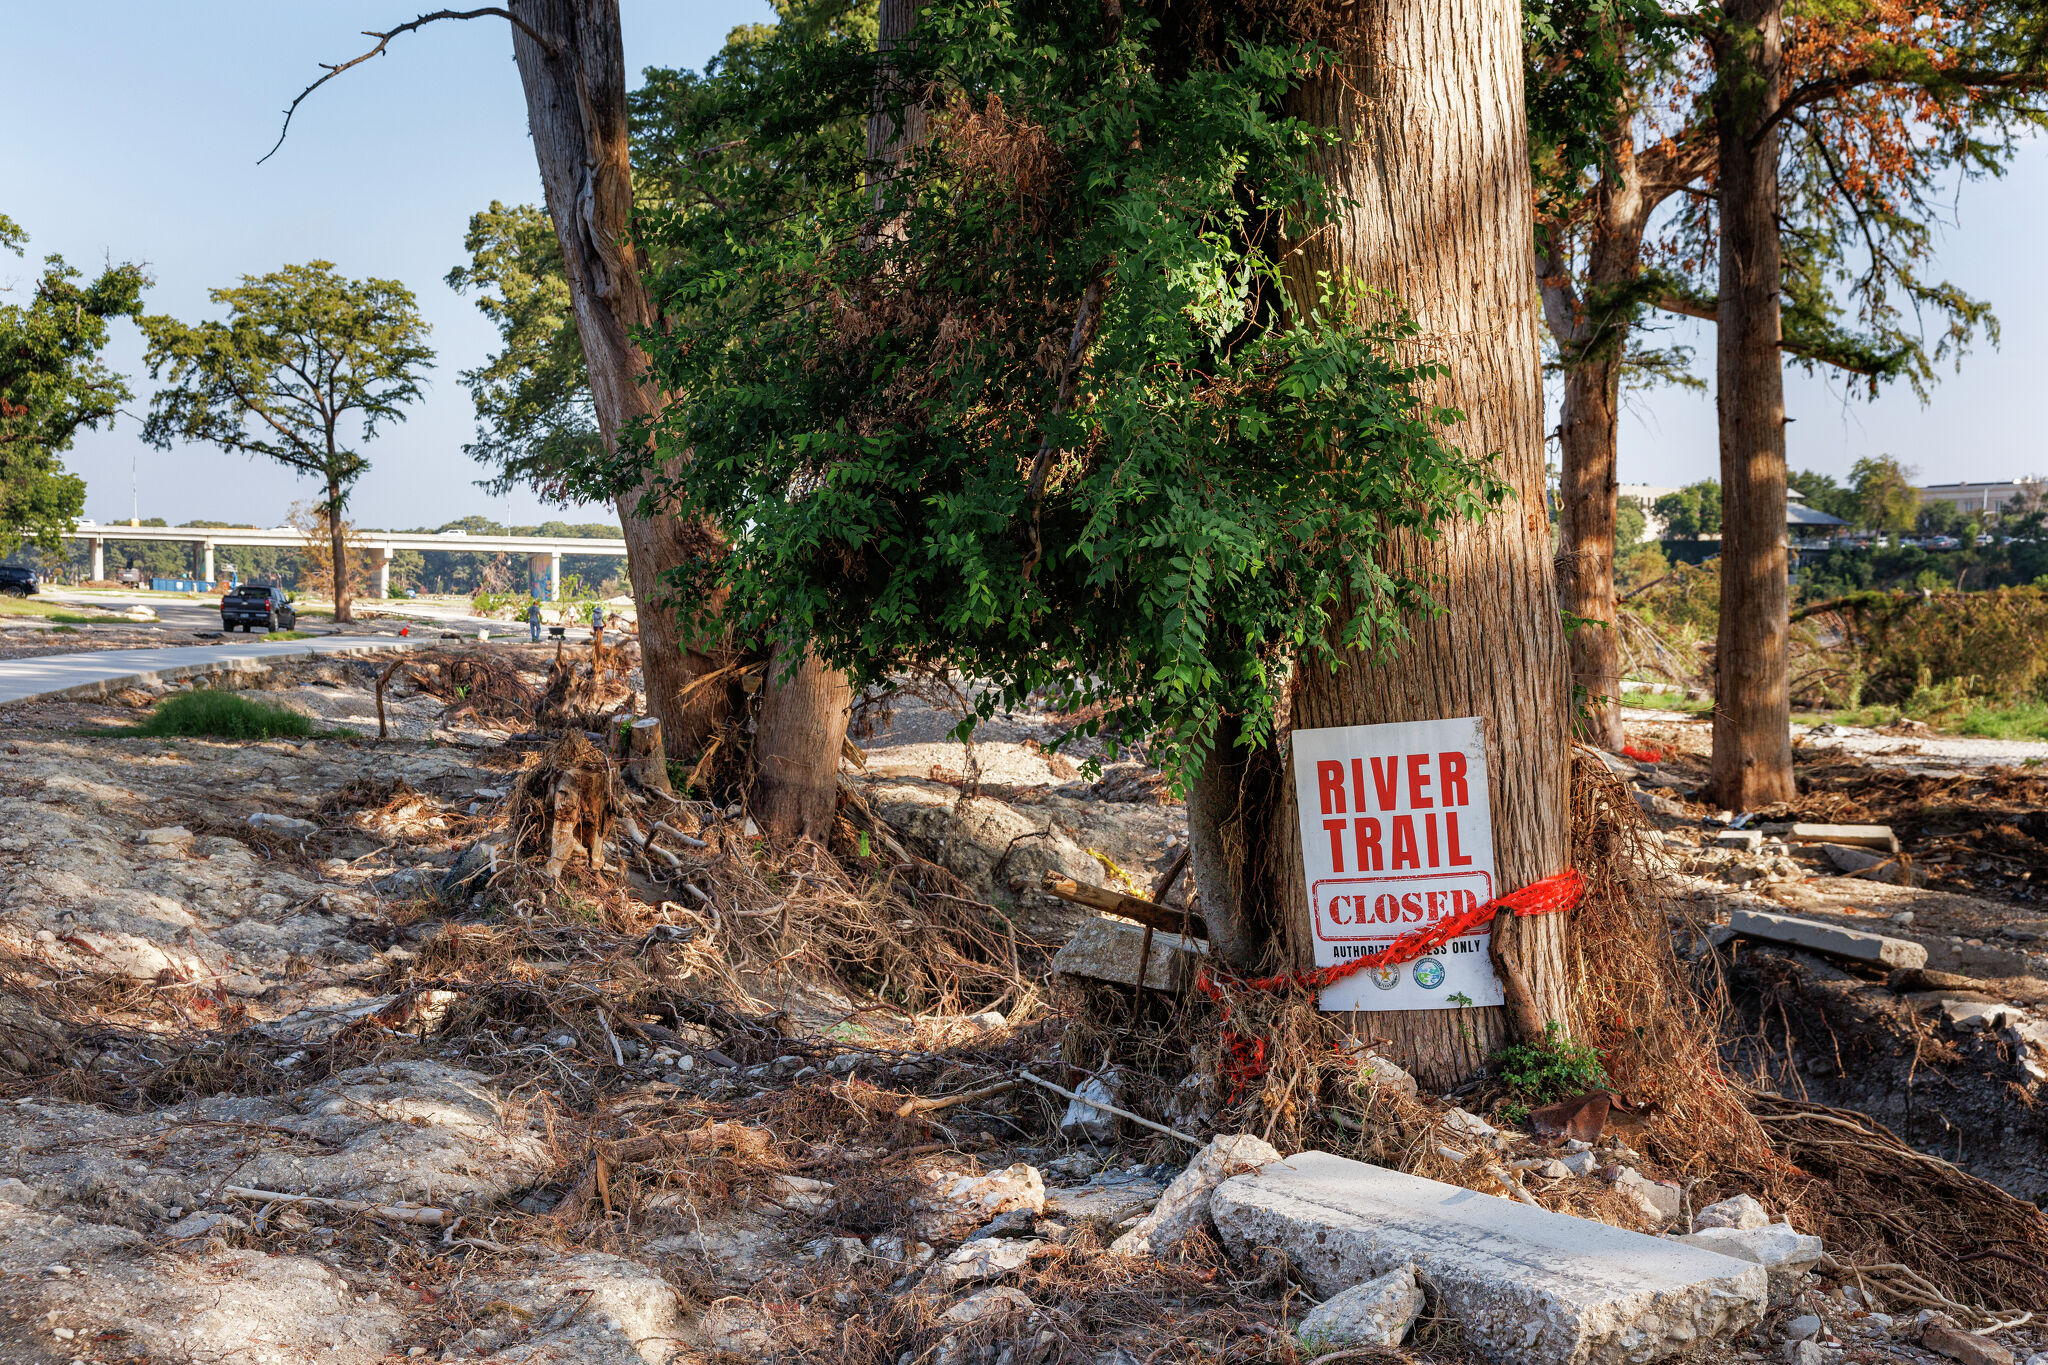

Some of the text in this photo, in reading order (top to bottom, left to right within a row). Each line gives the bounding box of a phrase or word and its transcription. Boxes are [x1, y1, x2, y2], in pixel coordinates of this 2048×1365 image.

[1317, 751, 1469, 814] RIVER
[1323, 811, 1472, 873] TRAIL
[1329, 889, 1477, 925] CLOSED
[1333, 944, 1390, 957] AUTHORIZ
[1452, 939, 1480, 954] ONLY
